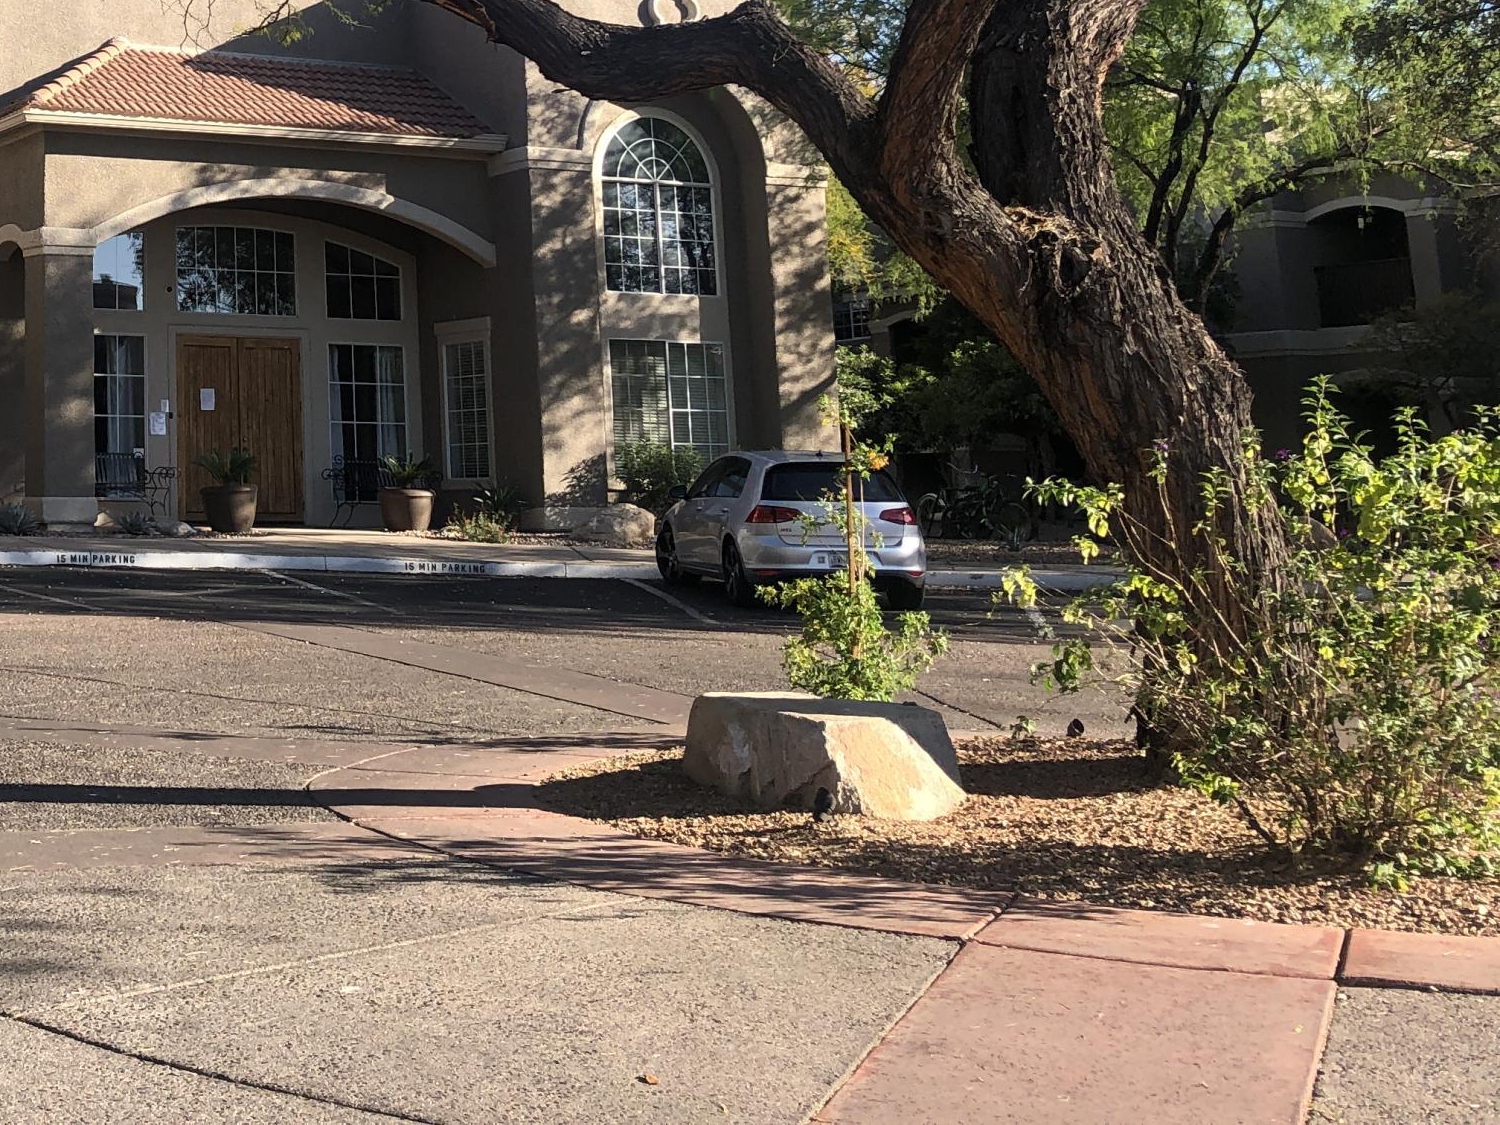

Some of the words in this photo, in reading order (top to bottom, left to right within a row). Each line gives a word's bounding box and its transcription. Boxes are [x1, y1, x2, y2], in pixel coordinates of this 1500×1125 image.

[56, 554, 66, 563] 15
[70, 554, 88, 564] MIN
[92, 554, 136, 564] PARKING
[404, 562, 415, 571] 15
[418, 562, 437, 572] MIN
[441, 563, 486, 574] PARKING
